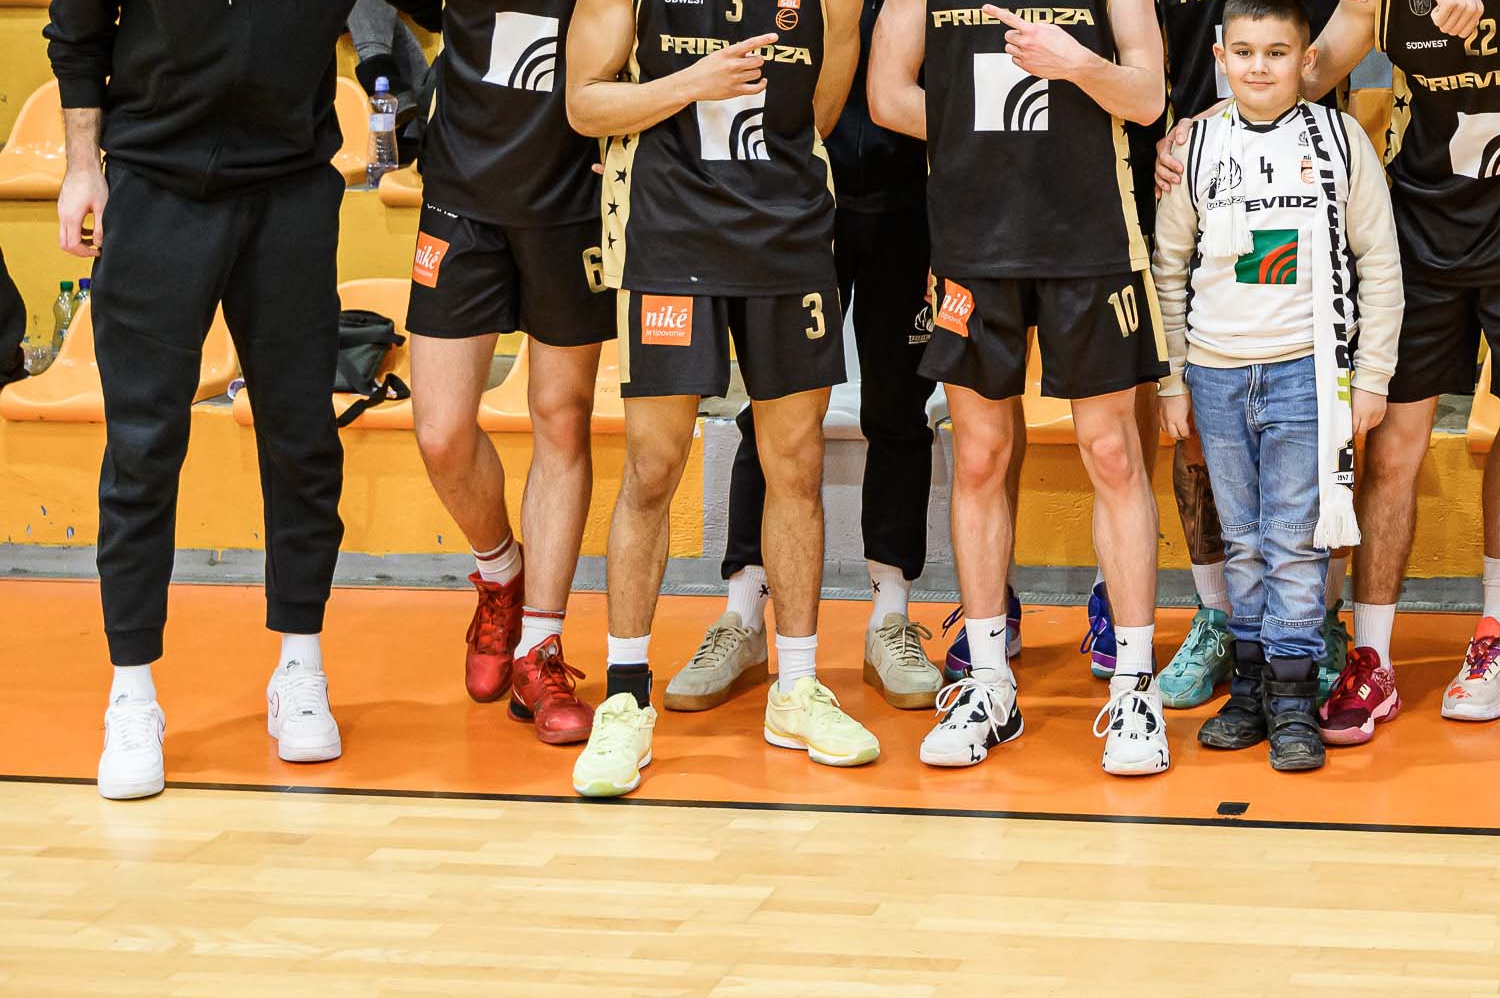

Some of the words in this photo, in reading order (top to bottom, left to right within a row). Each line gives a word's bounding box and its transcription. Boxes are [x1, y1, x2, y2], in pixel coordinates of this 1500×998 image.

[1406, 39, 1448, 50] SÜDWEST
[1259, 156, 1274, 184] 4
[1245, 195, 1318, 213] EVIDZ
[582, 246, 609, 293] 6
[645, 306, 688, 328] niké
[802, 292, 826, 340] 3
[1107, 284, 1139, 338] 10
